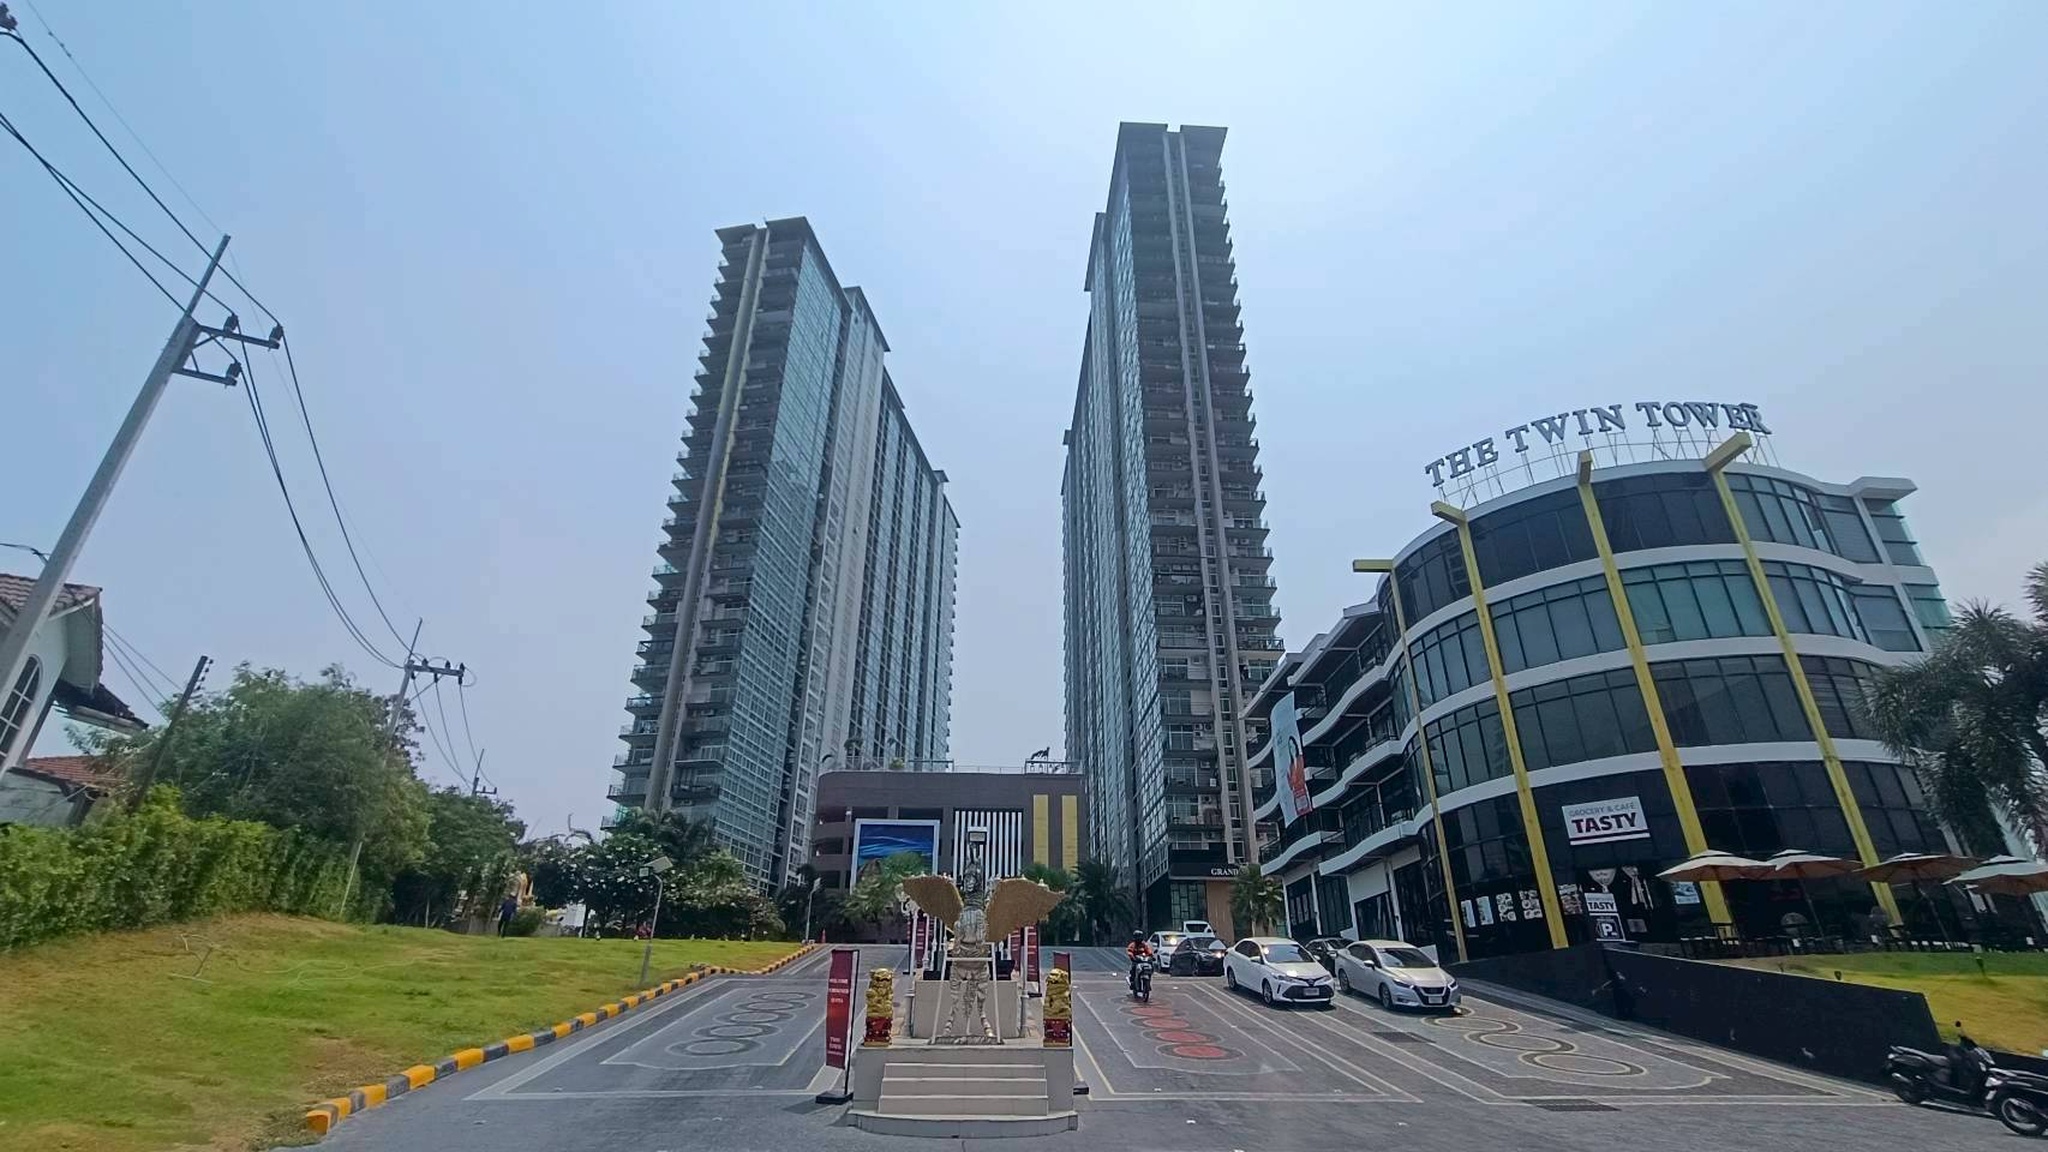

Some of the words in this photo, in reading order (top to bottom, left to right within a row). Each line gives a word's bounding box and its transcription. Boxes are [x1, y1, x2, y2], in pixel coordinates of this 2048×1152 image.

[1425, 437, 1499, 487] THE
[1505, 404, 1626, 453] TWIN
[1636, 402, 1772, 435] TOWER
[1569, 806, 1605, 817] GROCERY
[1571, 812, 1637, 834] TASTY
[1210, 868, 1239, 876] GRAND
[1588, 901, 1614, 910] TASTY
